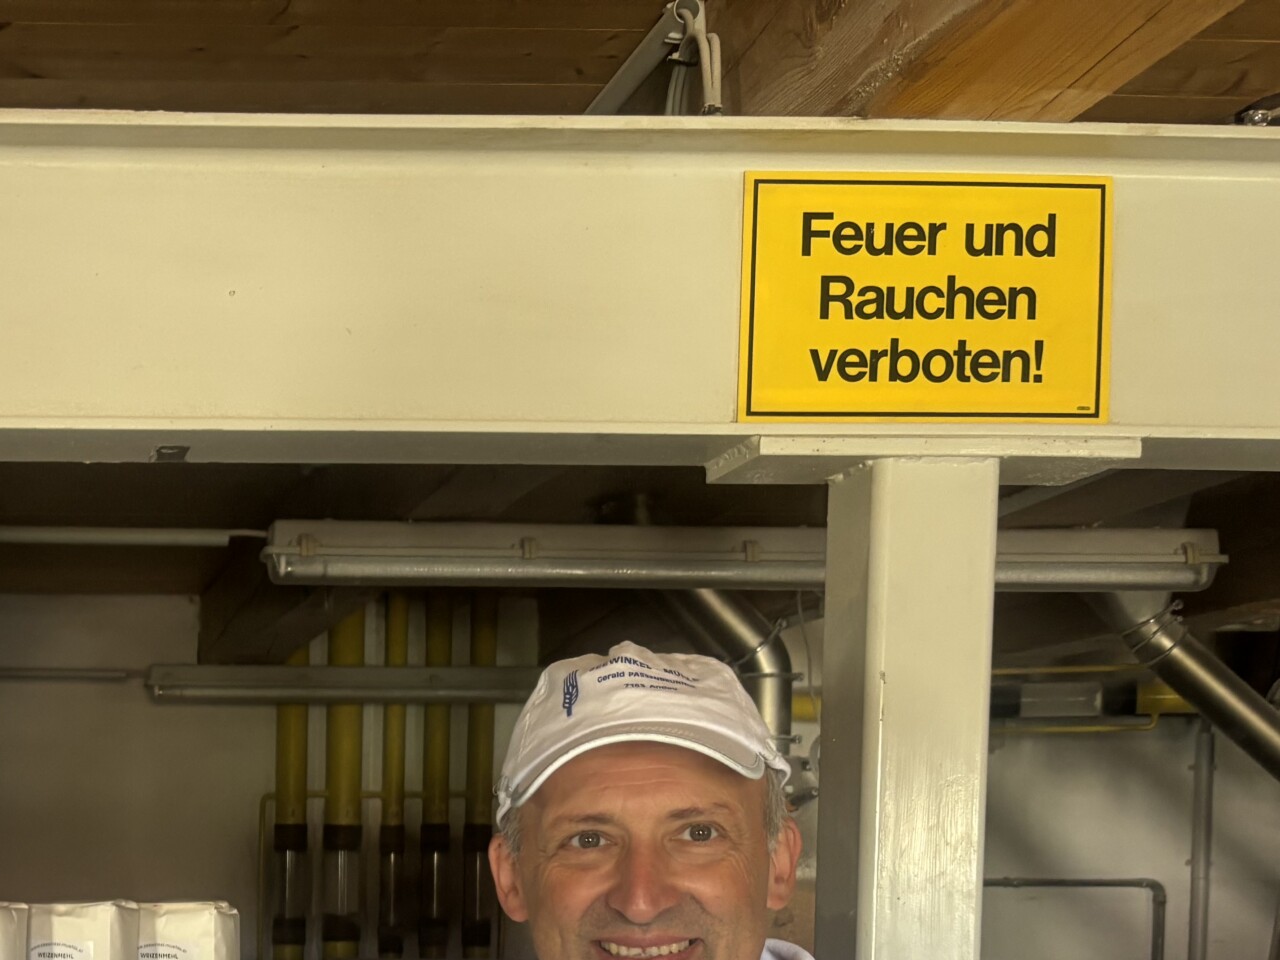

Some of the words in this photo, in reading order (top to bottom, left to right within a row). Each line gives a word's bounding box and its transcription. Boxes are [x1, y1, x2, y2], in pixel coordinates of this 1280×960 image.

[800, 211, 947, 257] Feuer
[964, 213, 1057, 258] und
[819, 274, 1037, 320] Rauchen
[809, 337, 1045, 384] verboten!
[597, 671, 625, 684] Gerald
